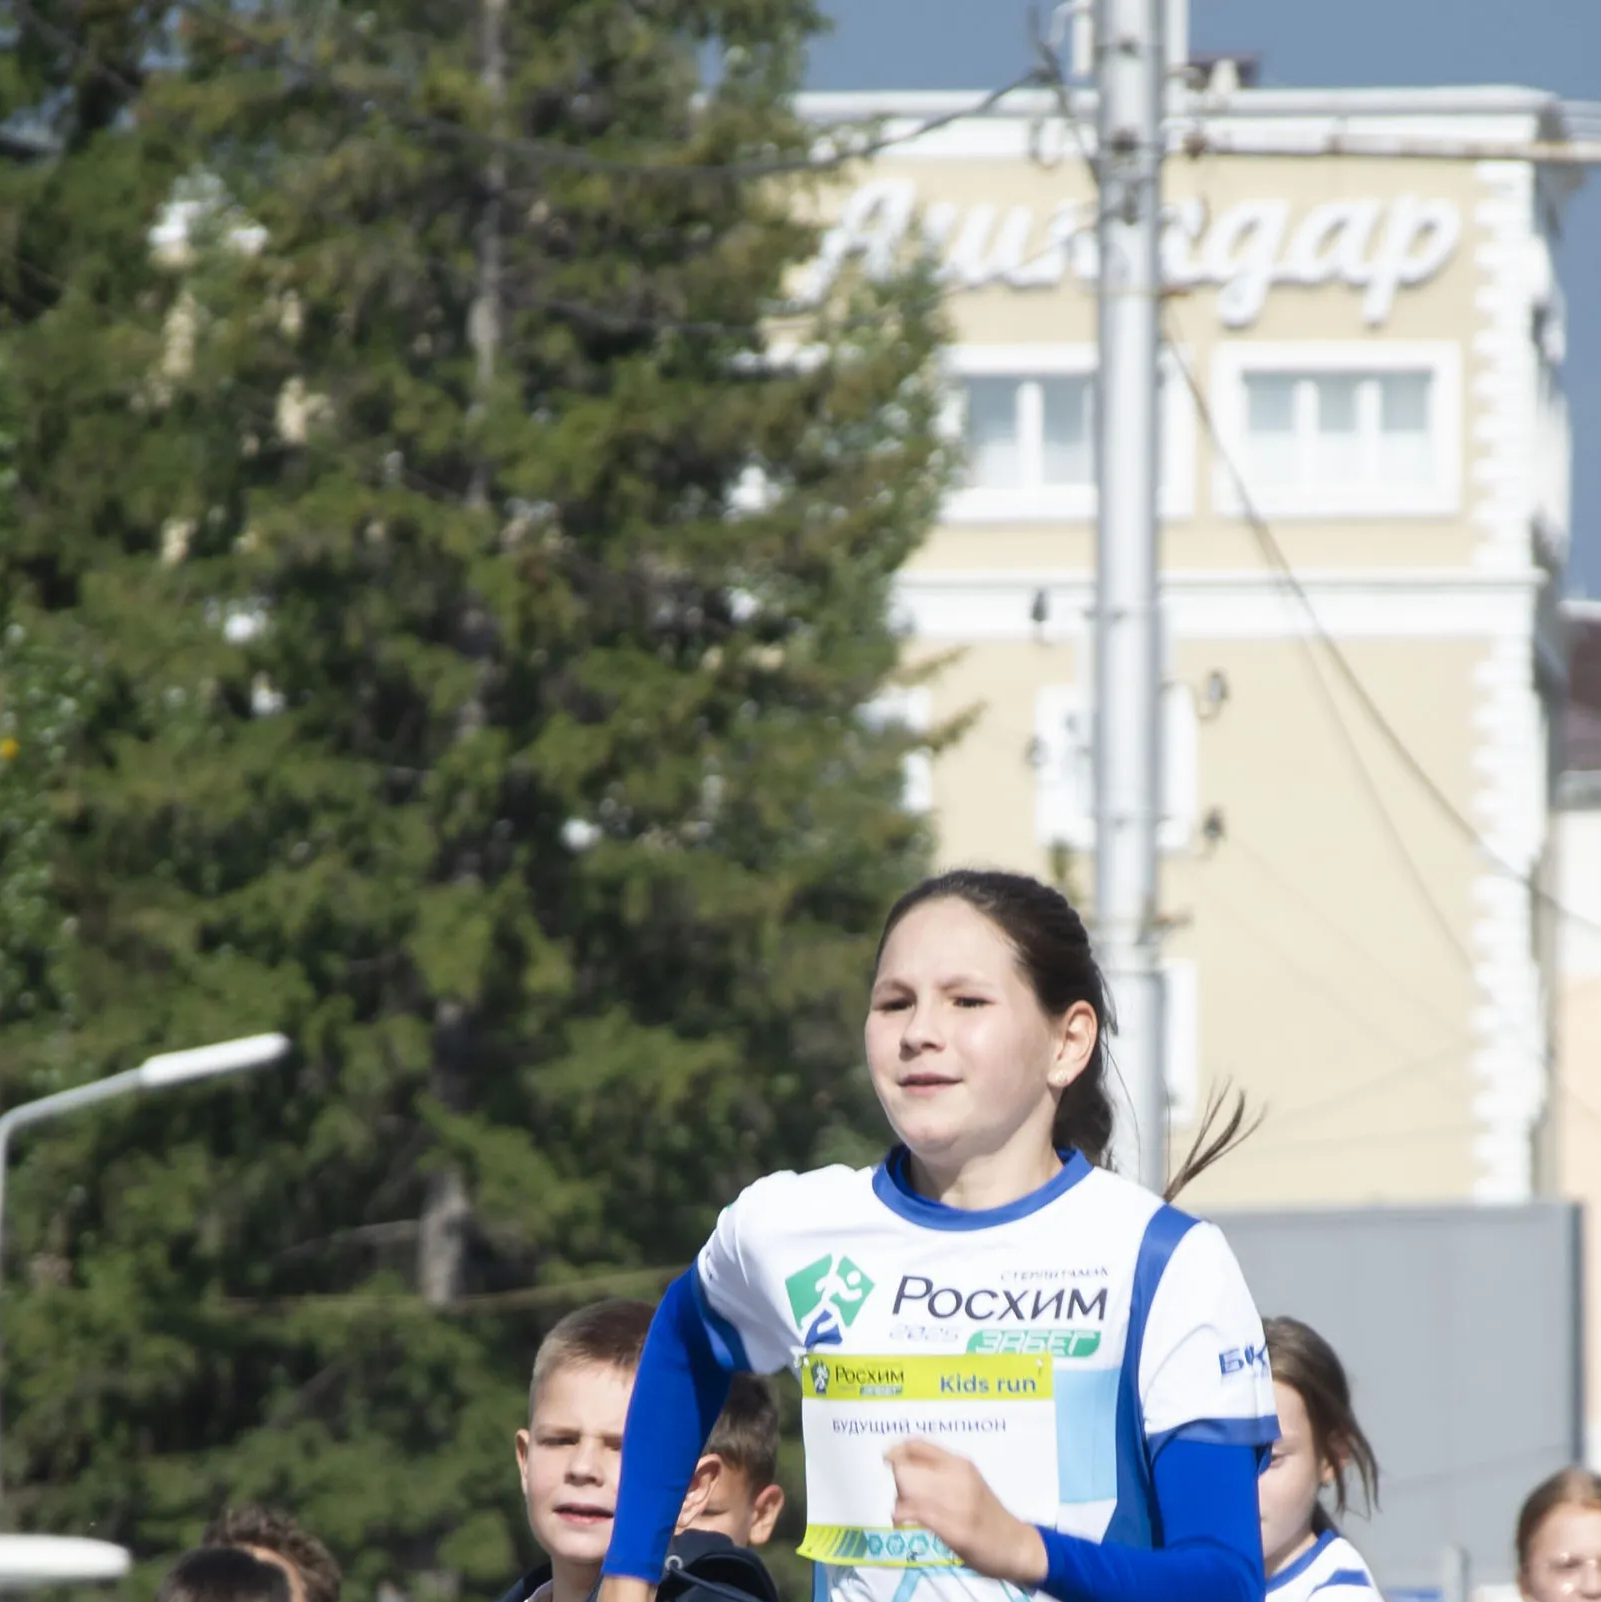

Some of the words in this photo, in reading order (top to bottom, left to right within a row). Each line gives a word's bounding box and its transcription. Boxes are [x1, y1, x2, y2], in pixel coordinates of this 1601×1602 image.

[940, 1374, 989, 1393] Kids
[997, 1376, 1037, 1393] run
[832, 1417, 909, 1435] БУДУЩИЙ
[915, 1418, 1007, 1433] ЧЕМПИОН
